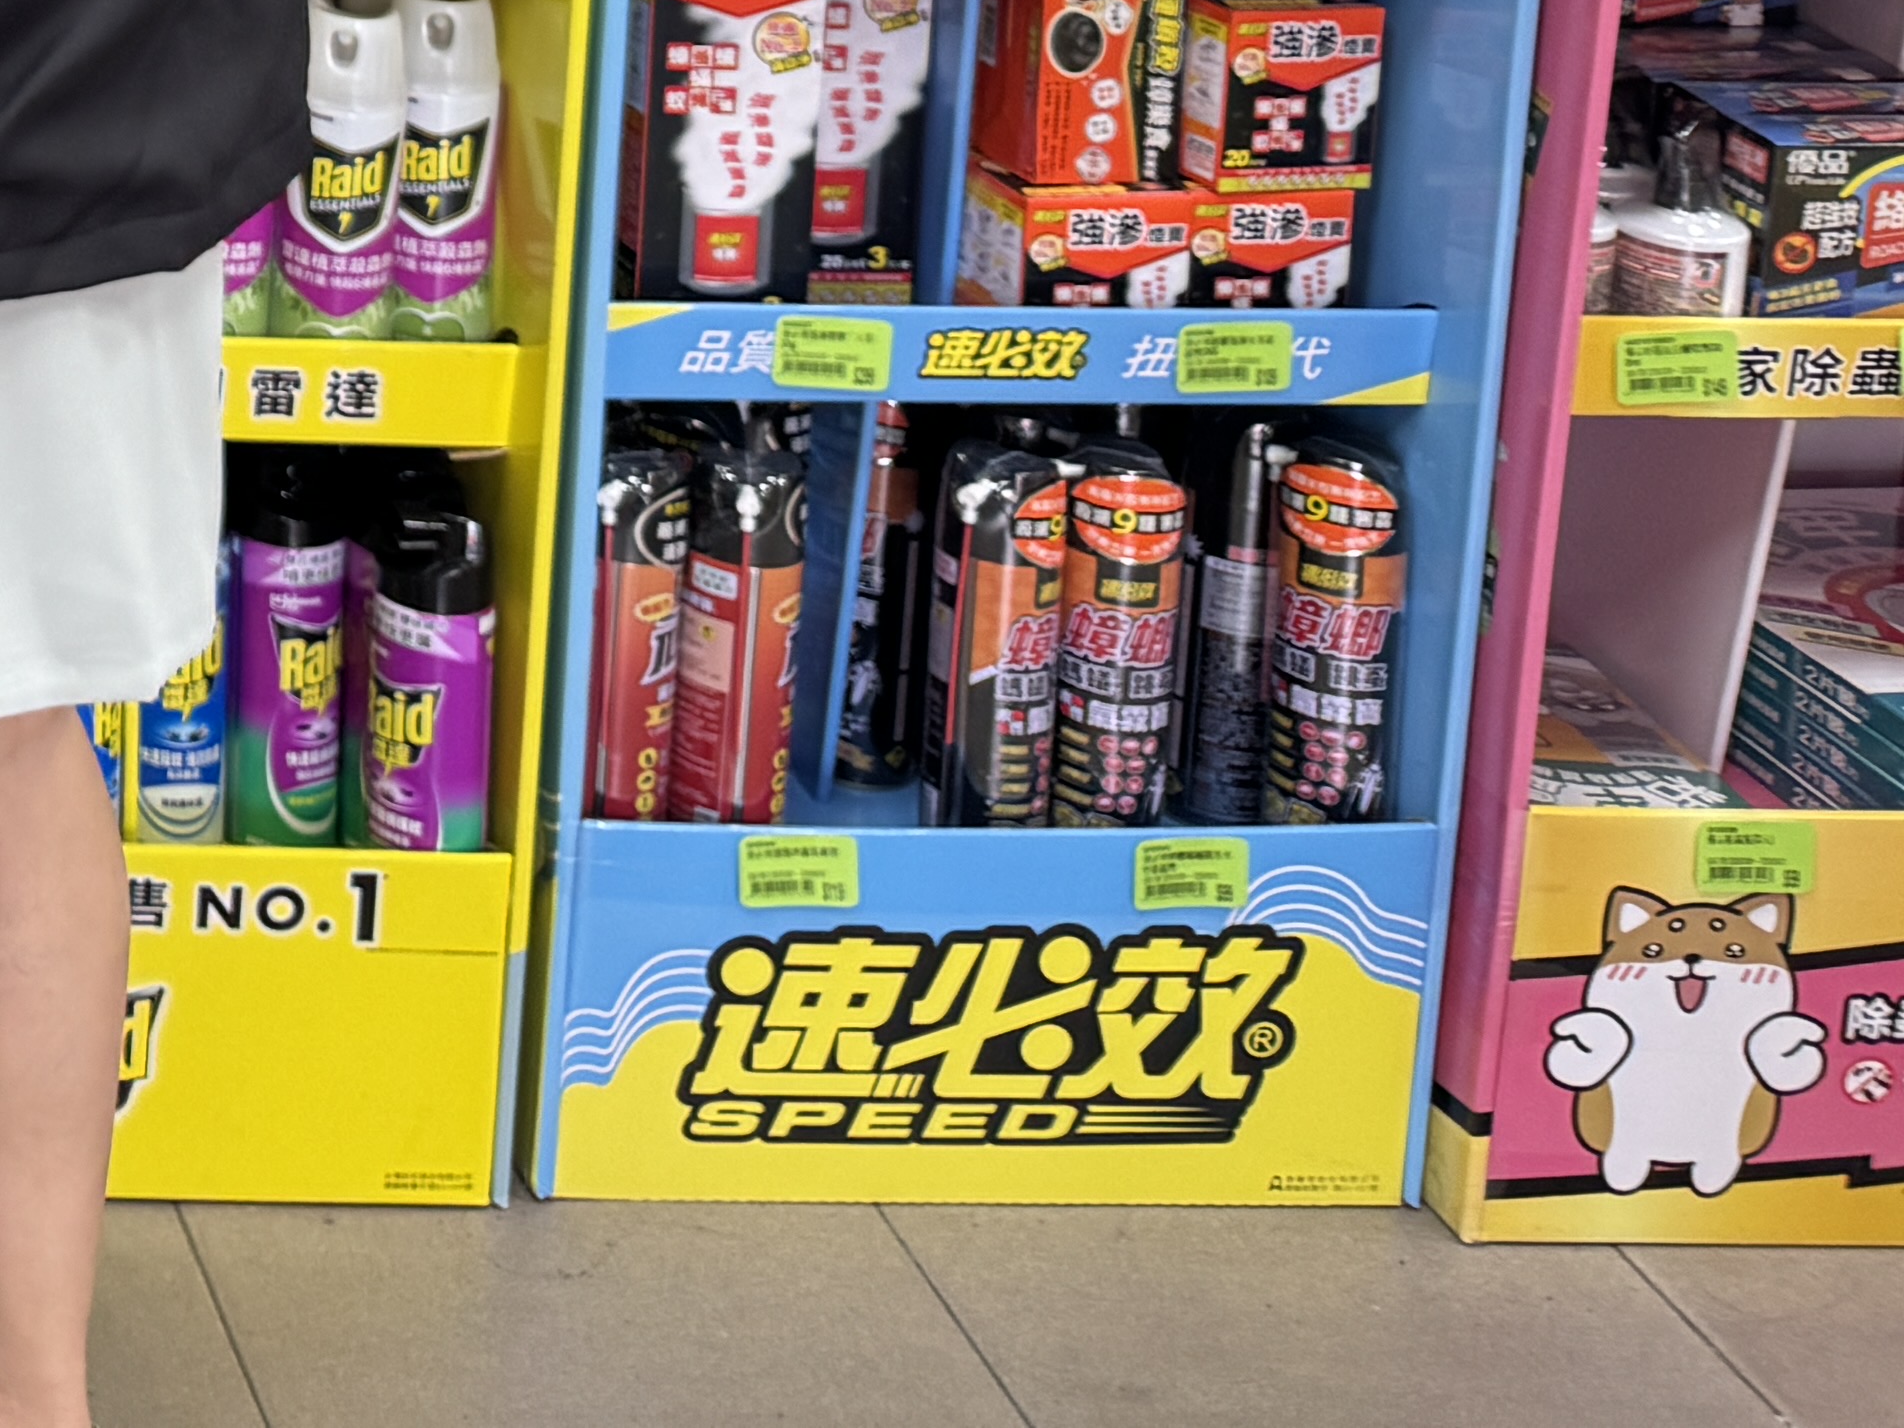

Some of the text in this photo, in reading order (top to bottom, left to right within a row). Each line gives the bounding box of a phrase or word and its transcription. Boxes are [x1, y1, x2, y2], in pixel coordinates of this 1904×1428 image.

[311, 152, 386, 198] Raid
[400, 137, 473, 182] Raid
[310, 193, 382, 210] ESSENTIALS
[920, 330, 1082, 379] 速必效
[251, 369, 379, 419] 雷達
[197, 871, 382, 944] NO.1
[690, 936, 1292, 1100] 速必效
[690, 1103, 1084, 1139] SPEED
